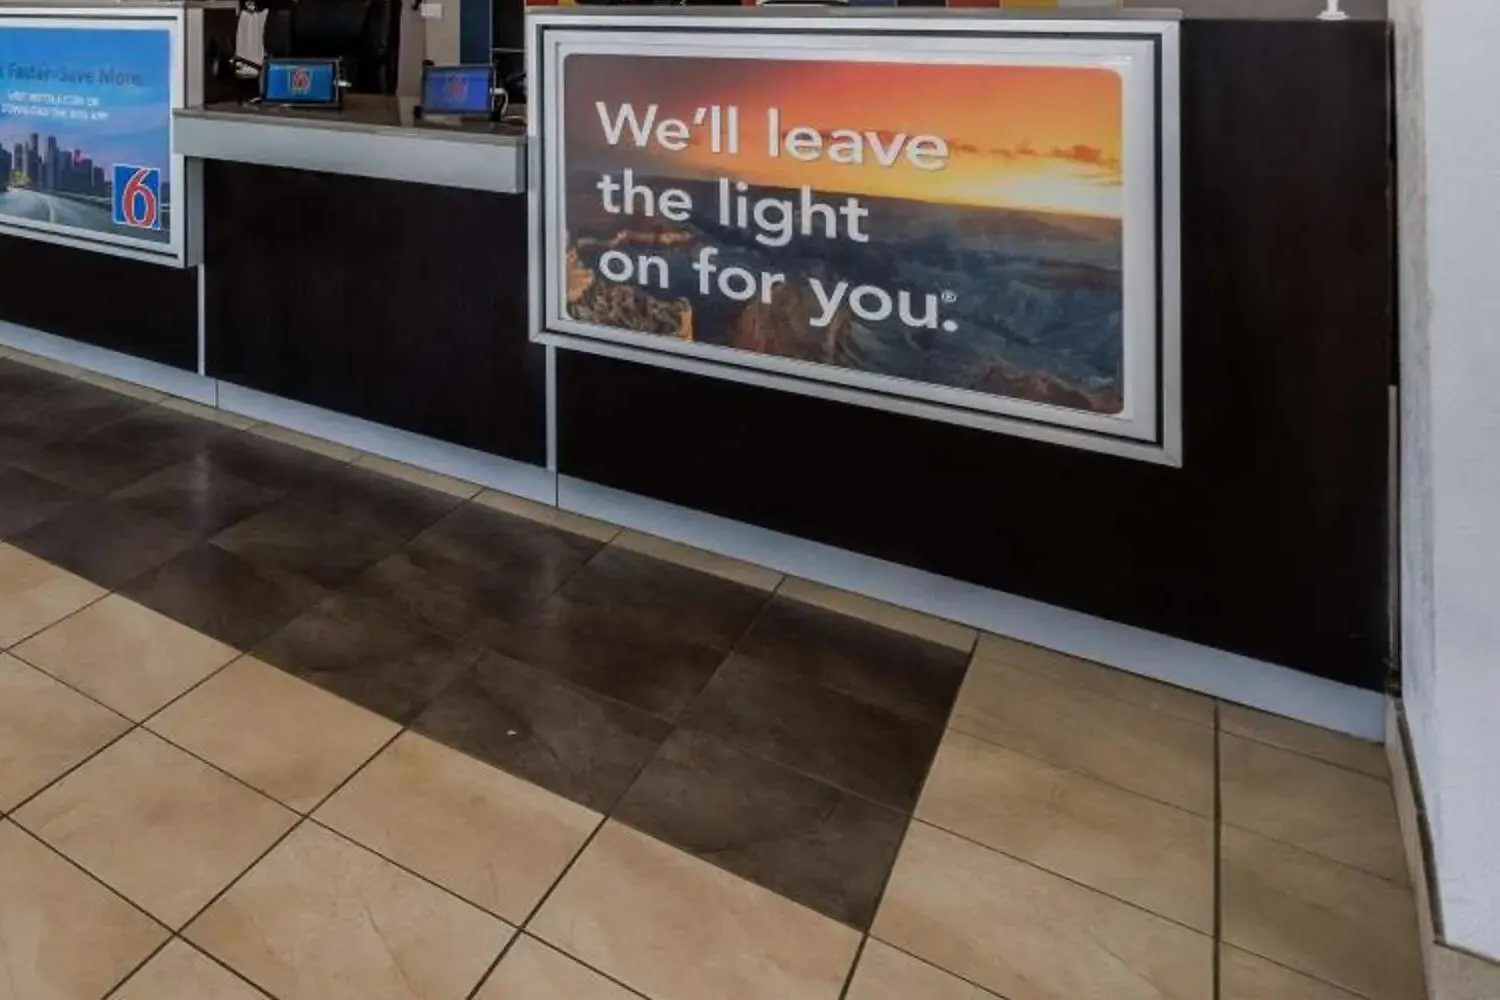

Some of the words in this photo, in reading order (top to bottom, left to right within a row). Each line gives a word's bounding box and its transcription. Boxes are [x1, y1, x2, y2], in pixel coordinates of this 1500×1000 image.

[767, 107, 949, 171] leave
[122, 167, 157, 228] 6
[597, 168, 693, 221] the
[718, 176, 869, 247] light
[598, 250, 669, 290] on
[692, 247, 785, 304] for
